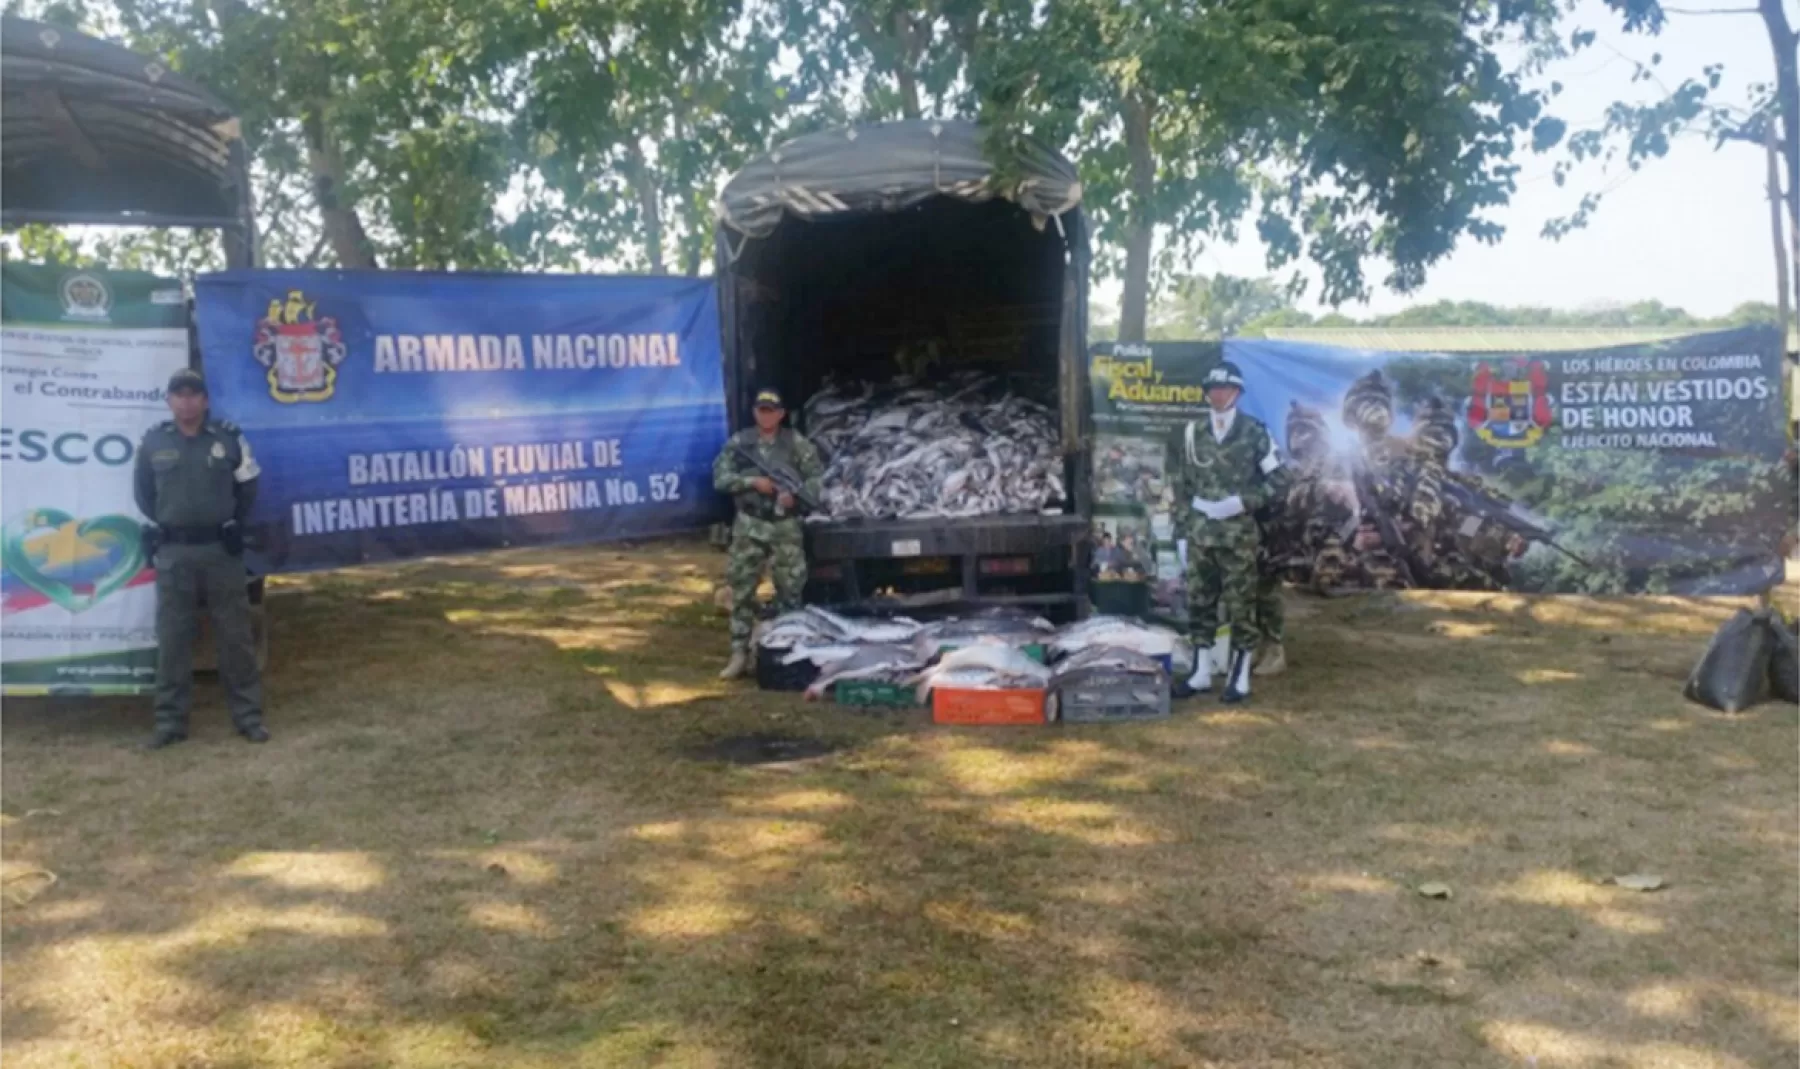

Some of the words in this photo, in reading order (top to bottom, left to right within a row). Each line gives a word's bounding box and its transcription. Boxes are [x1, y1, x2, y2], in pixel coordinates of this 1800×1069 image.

[374, 334, 526, 373] ARMADA
[532, 332, 680, 370] NACIONAL
[1562, 358, 1590, 374] LOS
[1595, 356, 1653, 373] HÉROES
[1657, 356, 1676, 371] EN
[1681, 353, 1762, 371] COLOMBIA
[1092, 355, 1152, 378] Fiscal
[13, 381, 33, 395] el
[1561, 376, 1638, 404] ESTÁN
[1647, 375, 1768, 402] VESTIDOS
[1562, 406, 1595, 429] DE
[1602, 404, 1694, 429] HONOR
[1561, 433, 1633, 449] EJÉRCITO
[1637, 431, 1717, 447] NACIONAL
[348, 443, 485, 486] BATALLÓN
[493, 441, 589, 476] FLUVIAL
[593, 438, 623, 469] DE
[292, 487, 459, 536] INFANTERÍA
[464, 488, 499, 519] DE
[503, 480, 601, 517] MARINA
[605, 478, 646, 506] No.
[649, 471, 682, 501] 52
